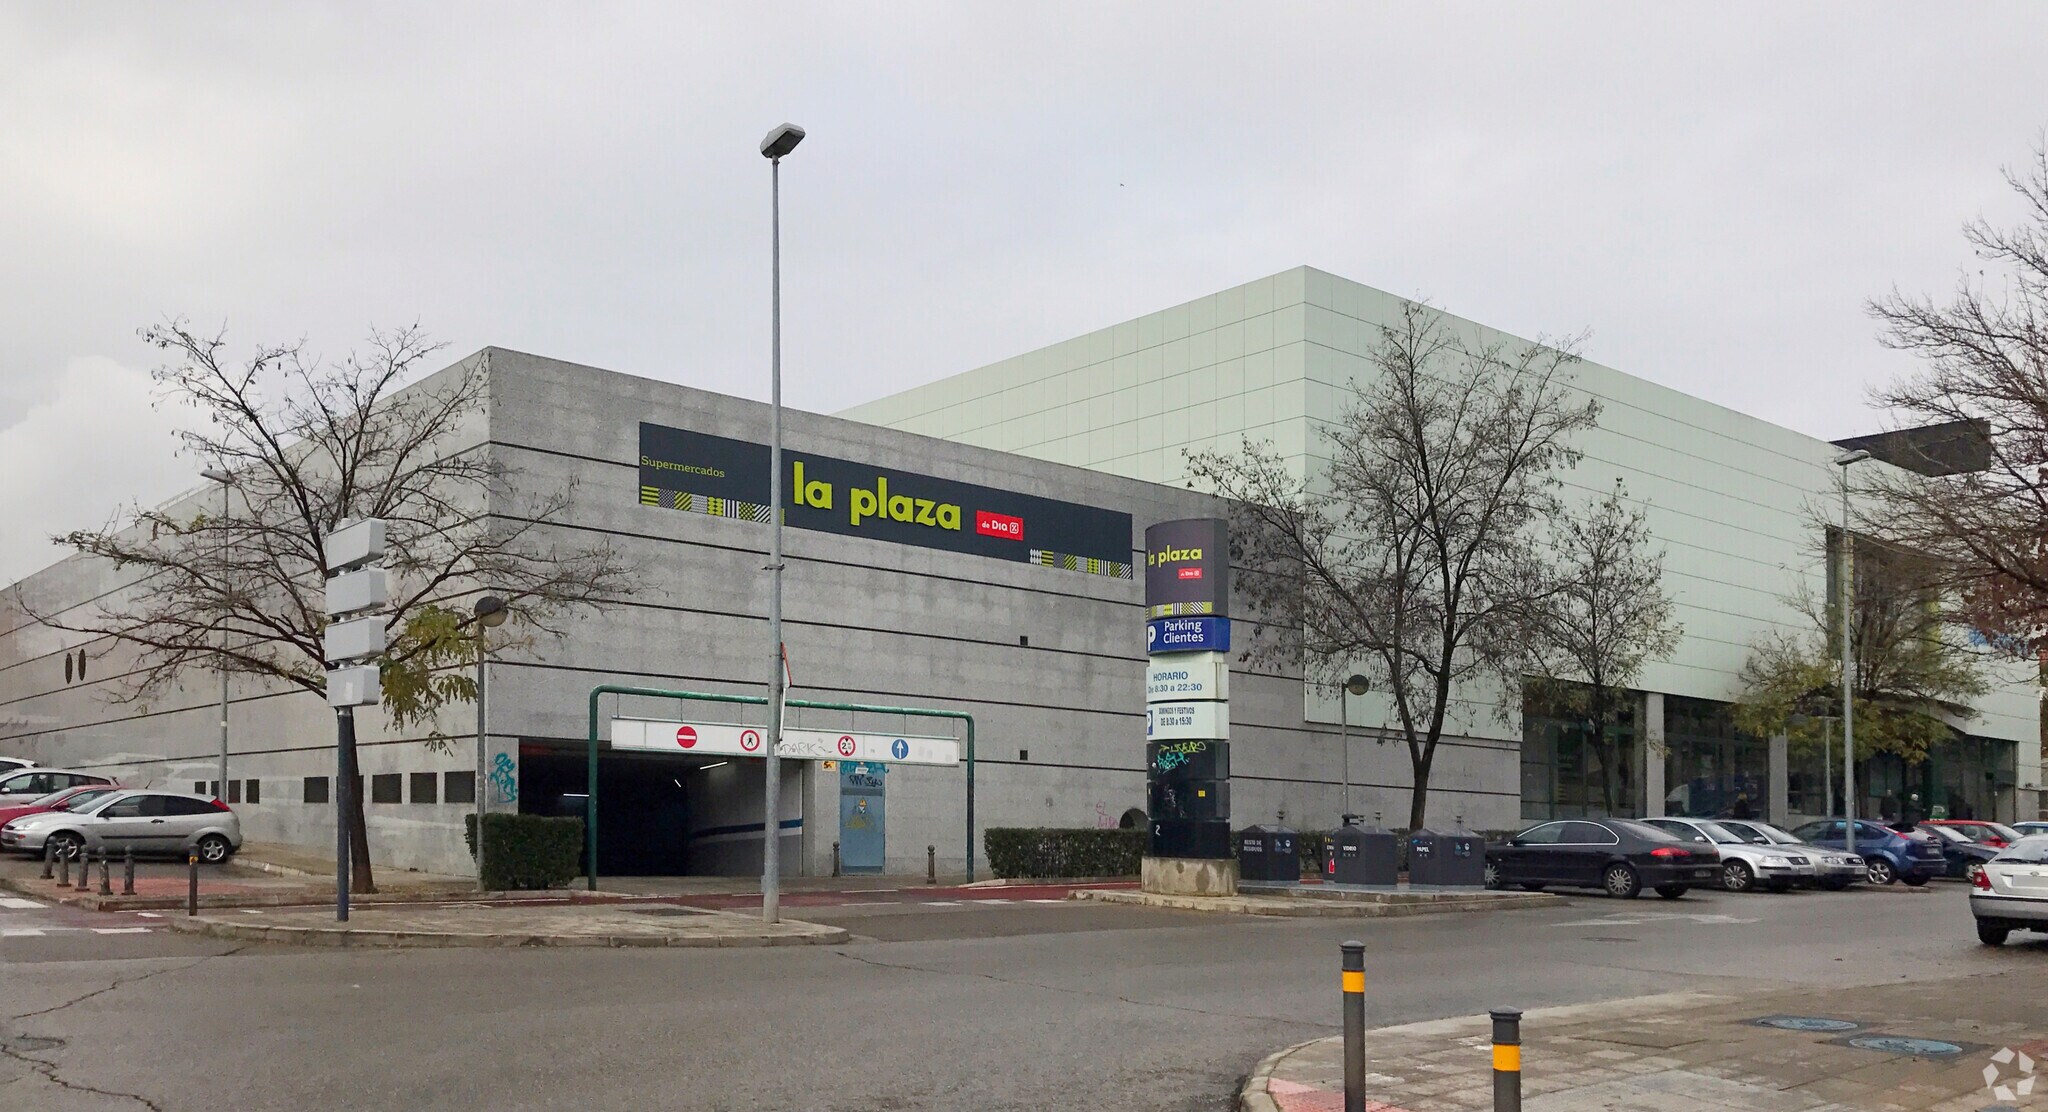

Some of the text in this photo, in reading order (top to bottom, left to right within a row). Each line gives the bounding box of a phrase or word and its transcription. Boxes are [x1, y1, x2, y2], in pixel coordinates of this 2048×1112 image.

[641, 455, 725, 478] Supermercados
[793, 461, 961, 531] la plaza
[981, 521, 990, 529] de
[1158, 544, 1202, 568] plaza
[1164, 620, 1203, 633] Parking
[1147, 625, 1157, 652] P
[1163, 632, 1204, 644] Clientes
[1153, 671, 1189, 682] HORARIO
[1177, 683, 1203, 692] 22:30
